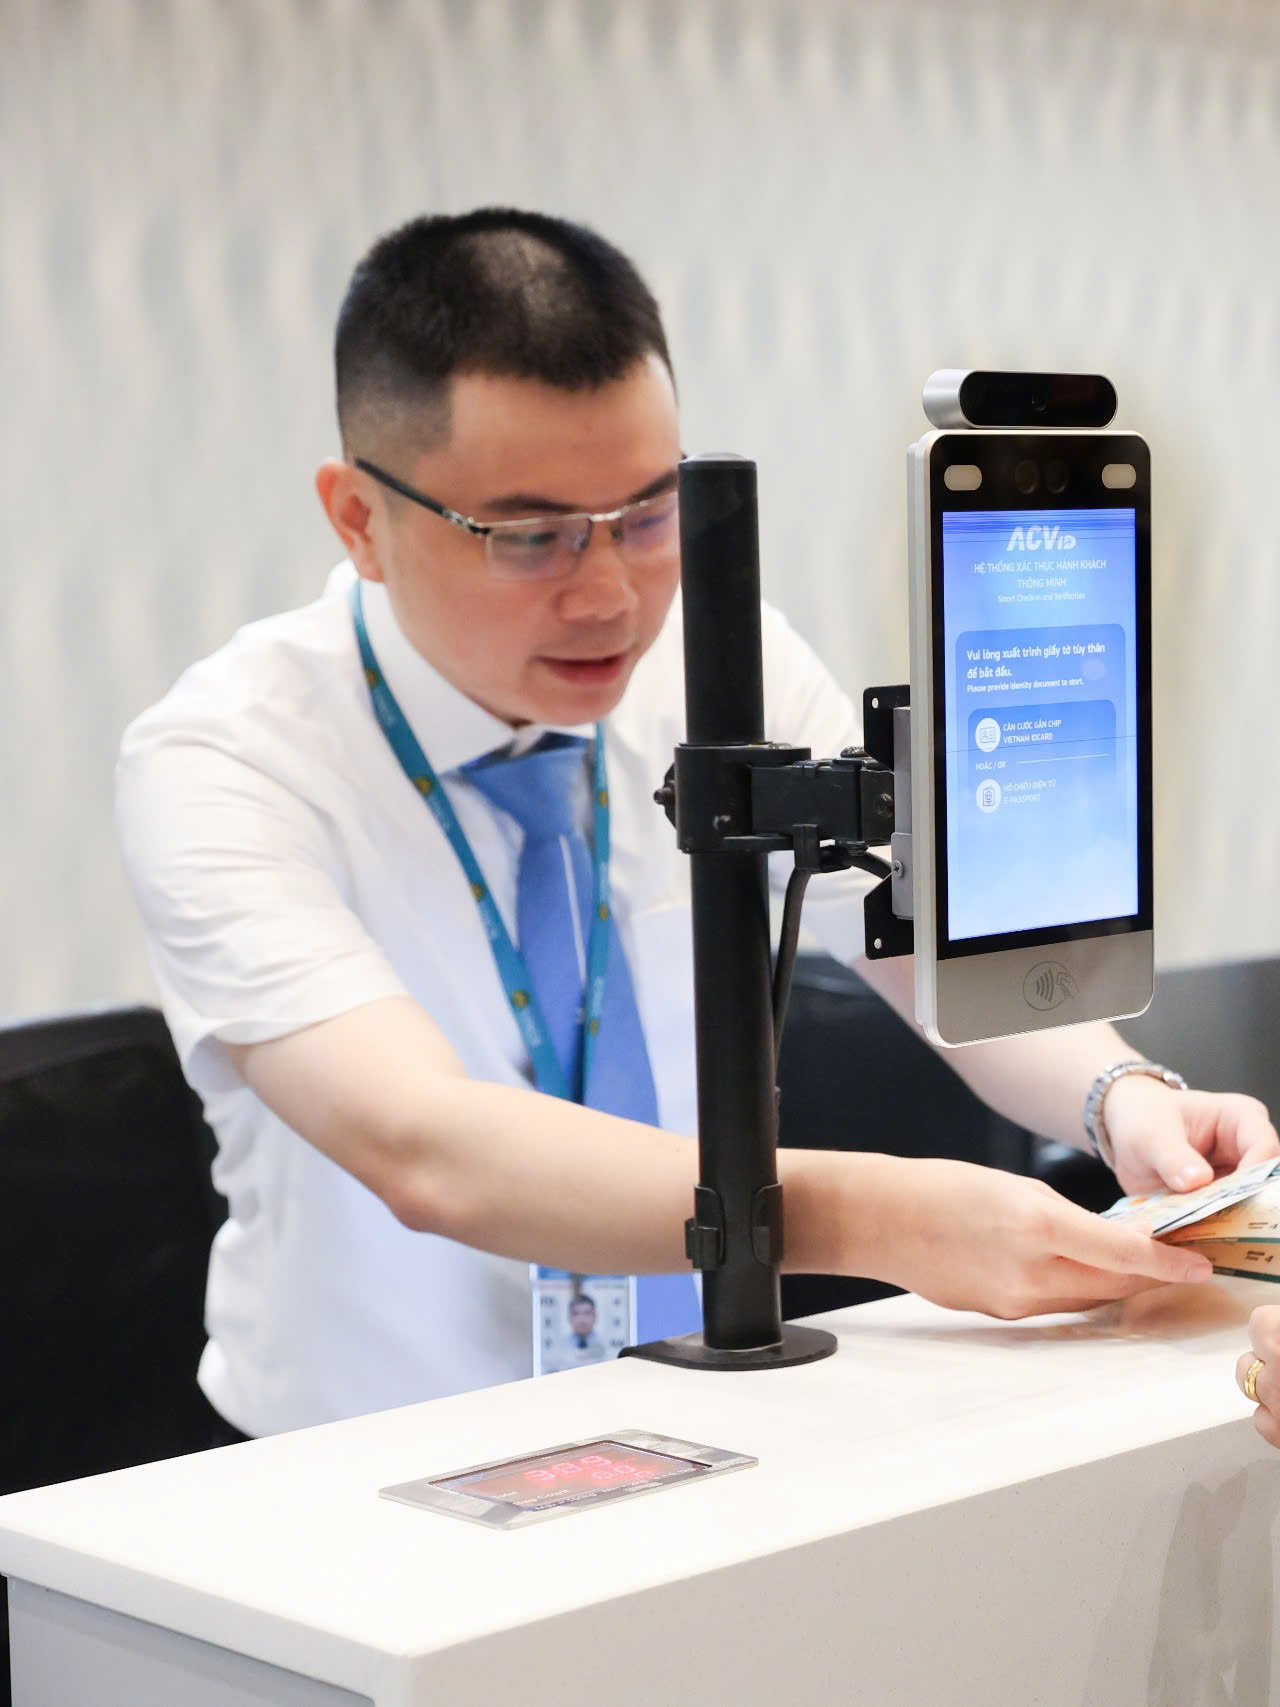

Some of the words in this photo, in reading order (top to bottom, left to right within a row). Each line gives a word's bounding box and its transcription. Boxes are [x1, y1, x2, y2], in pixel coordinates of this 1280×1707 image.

[1046, 577, 1066, 587] MINH
[966, 649, 980, 660] Vui
[982, 648, 1000, 661] lòng
[1002, 645, 1021, 658] xuất
[1022, 645, 1041, 658] trình
[1043, 644, 1060, 659] giấy
[1087, 642, 1105, 654] thân
[967, 684, 986, 693] Please
[988, 682, 1009, 693] provide
[1010, 680, 1032, 691] identity
[1033, 679, 1060, 688] document
[1047, 719, 1062, 729] CHIP
[1003, 734, 1030, 744] VIETNAM
